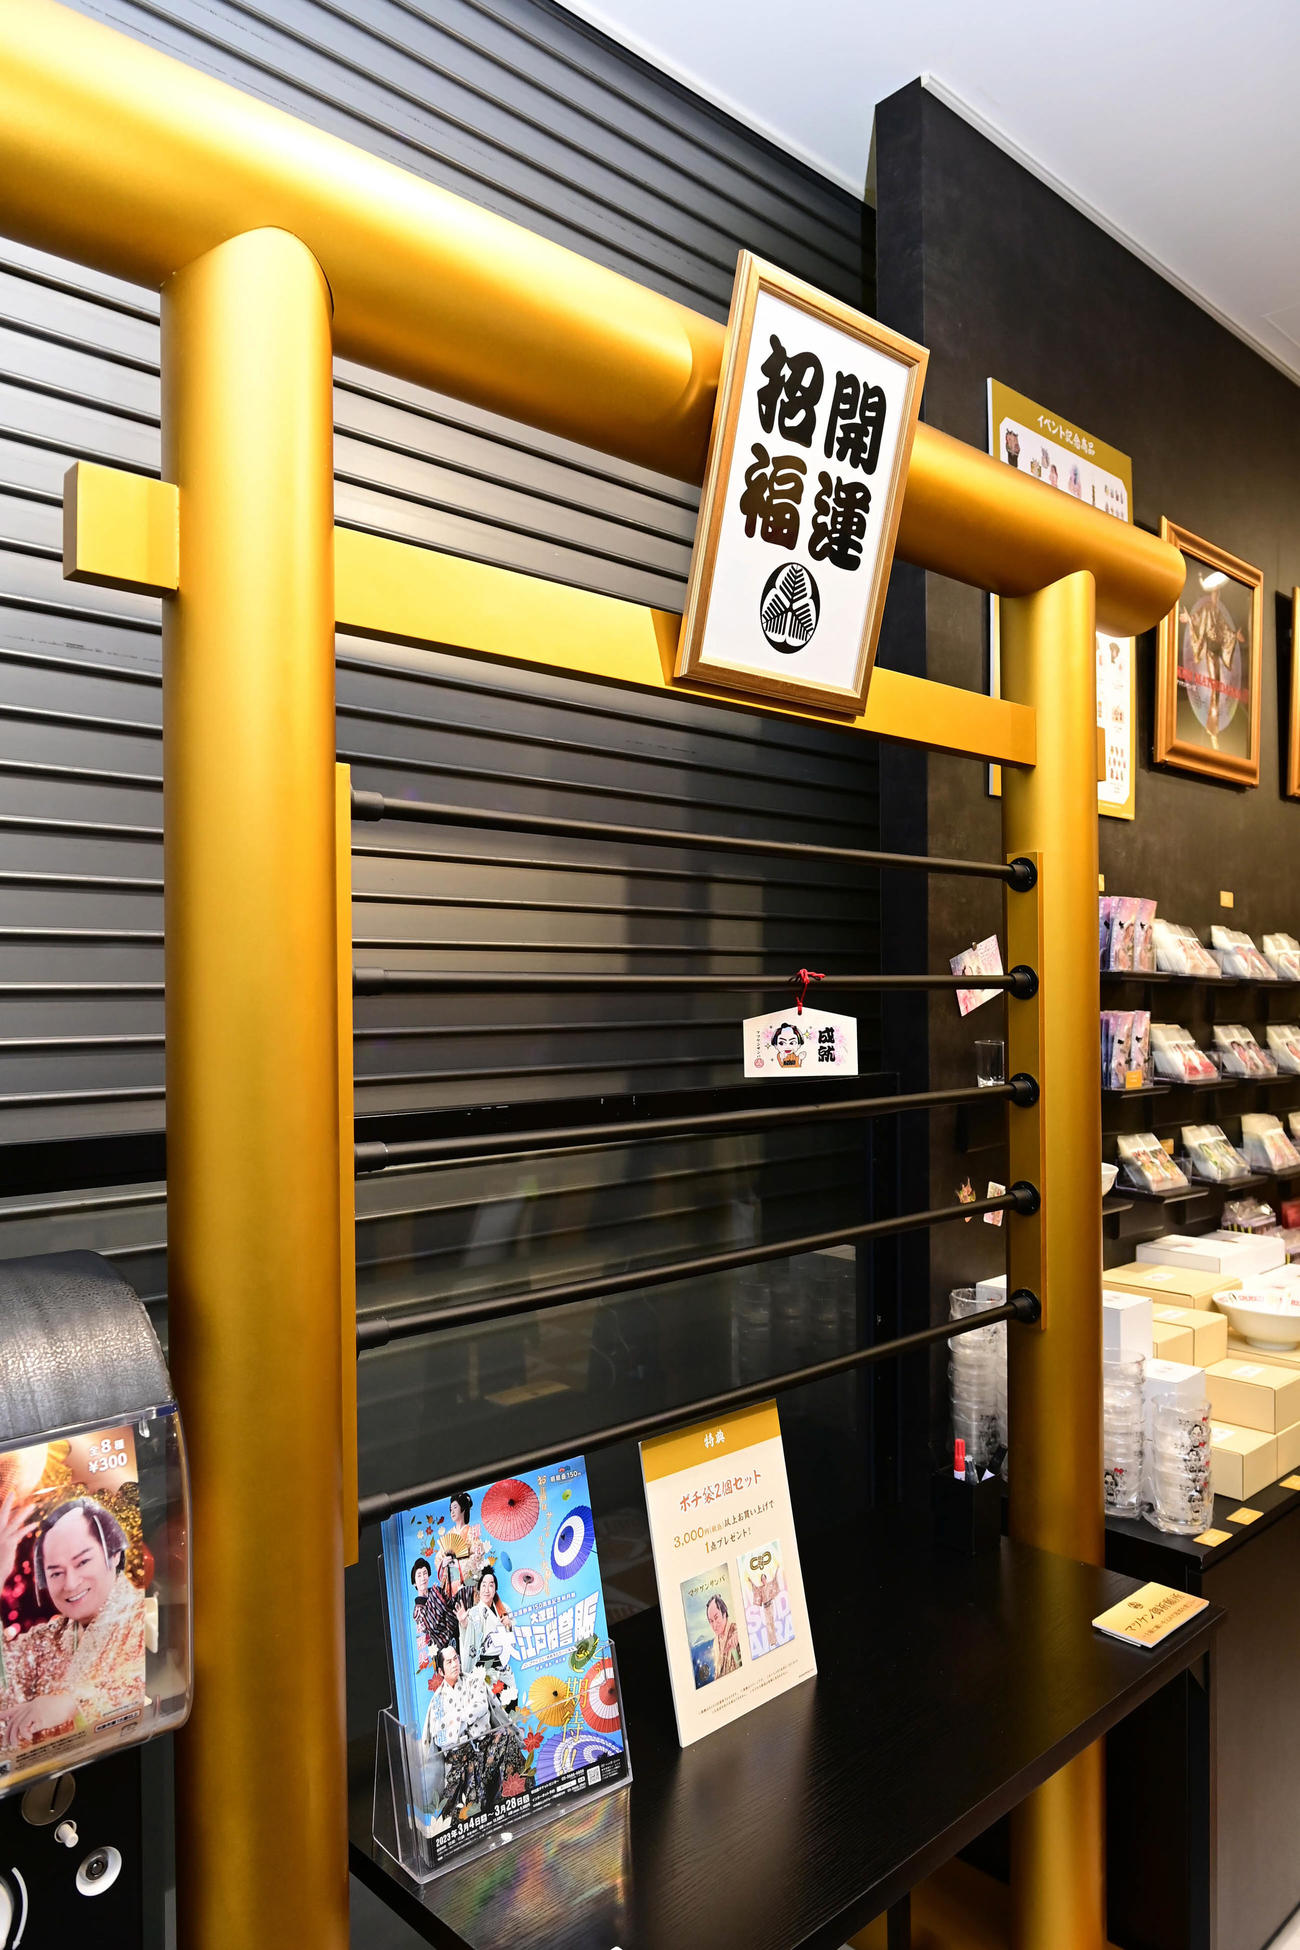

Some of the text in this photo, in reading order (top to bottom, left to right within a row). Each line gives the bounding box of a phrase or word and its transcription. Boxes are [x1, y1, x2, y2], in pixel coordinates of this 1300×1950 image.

[738, 333, 825, 551] 招福
[807, 370, 887, 572] 開運
[703, 1429, 725, 1449] 特典
[88, 1452, 128, 1474] ¥300
[680, 1469, 761, 1512] ポチ袋2個セット
